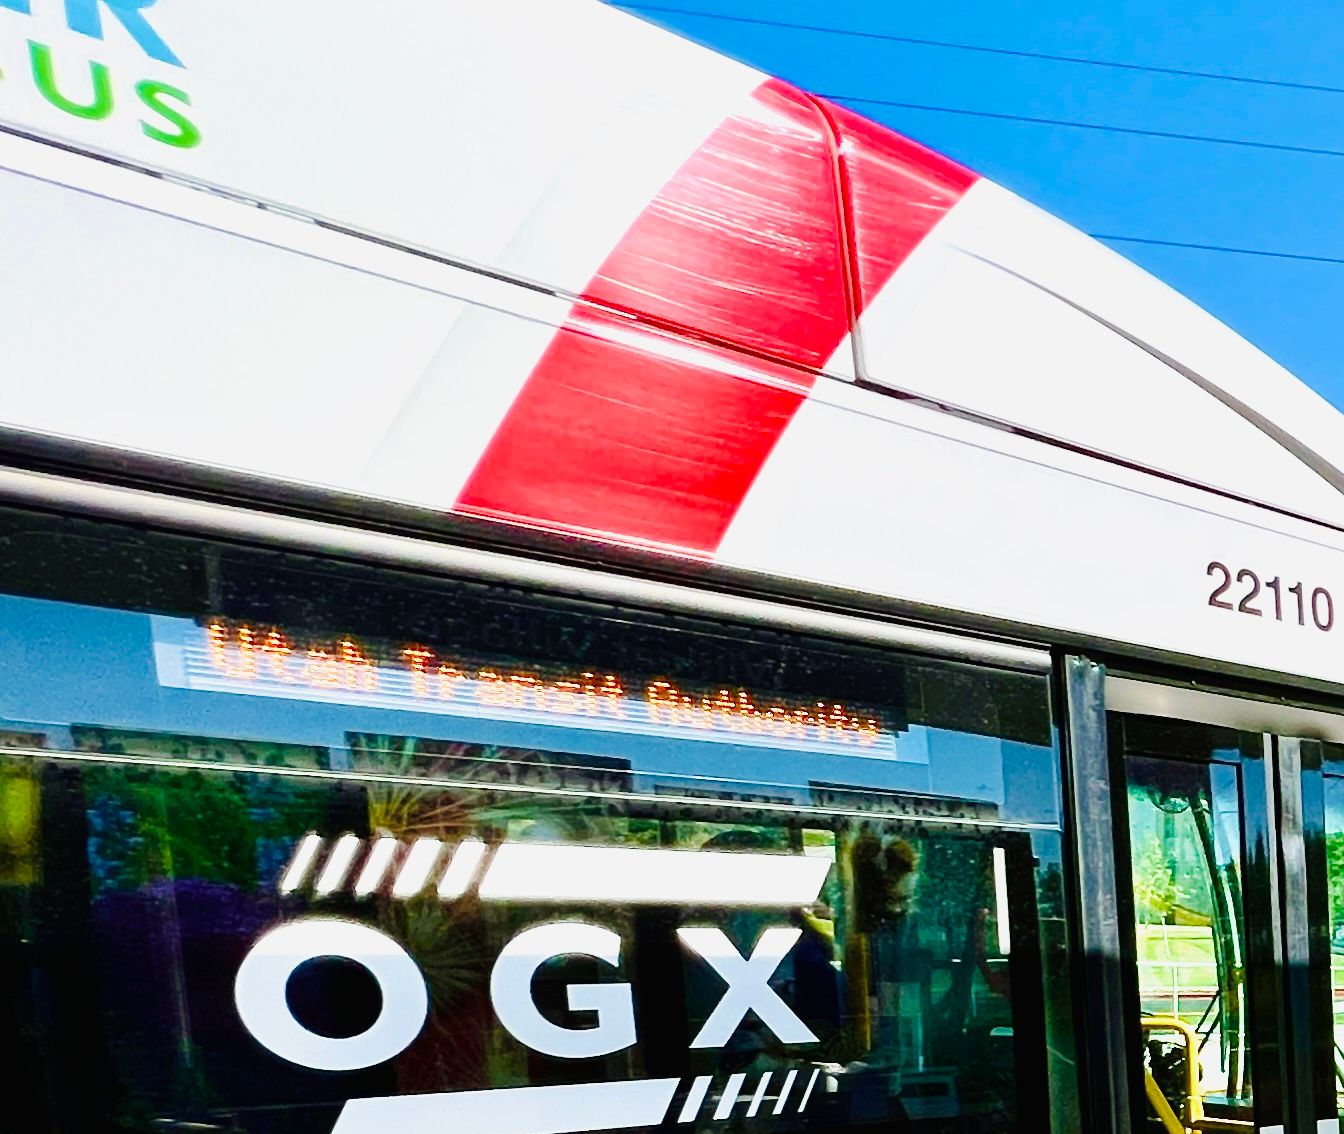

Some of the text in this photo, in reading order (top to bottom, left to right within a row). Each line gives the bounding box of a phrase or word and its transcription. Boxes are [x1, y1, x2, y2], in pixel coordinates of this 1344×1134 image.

[0, 38, 202, 149] US
[1206, 560, 1334, 632] 22110
[206, 616, 880, 747] Utah Transit Authority
[234, 918, 820, 1071] OGX
